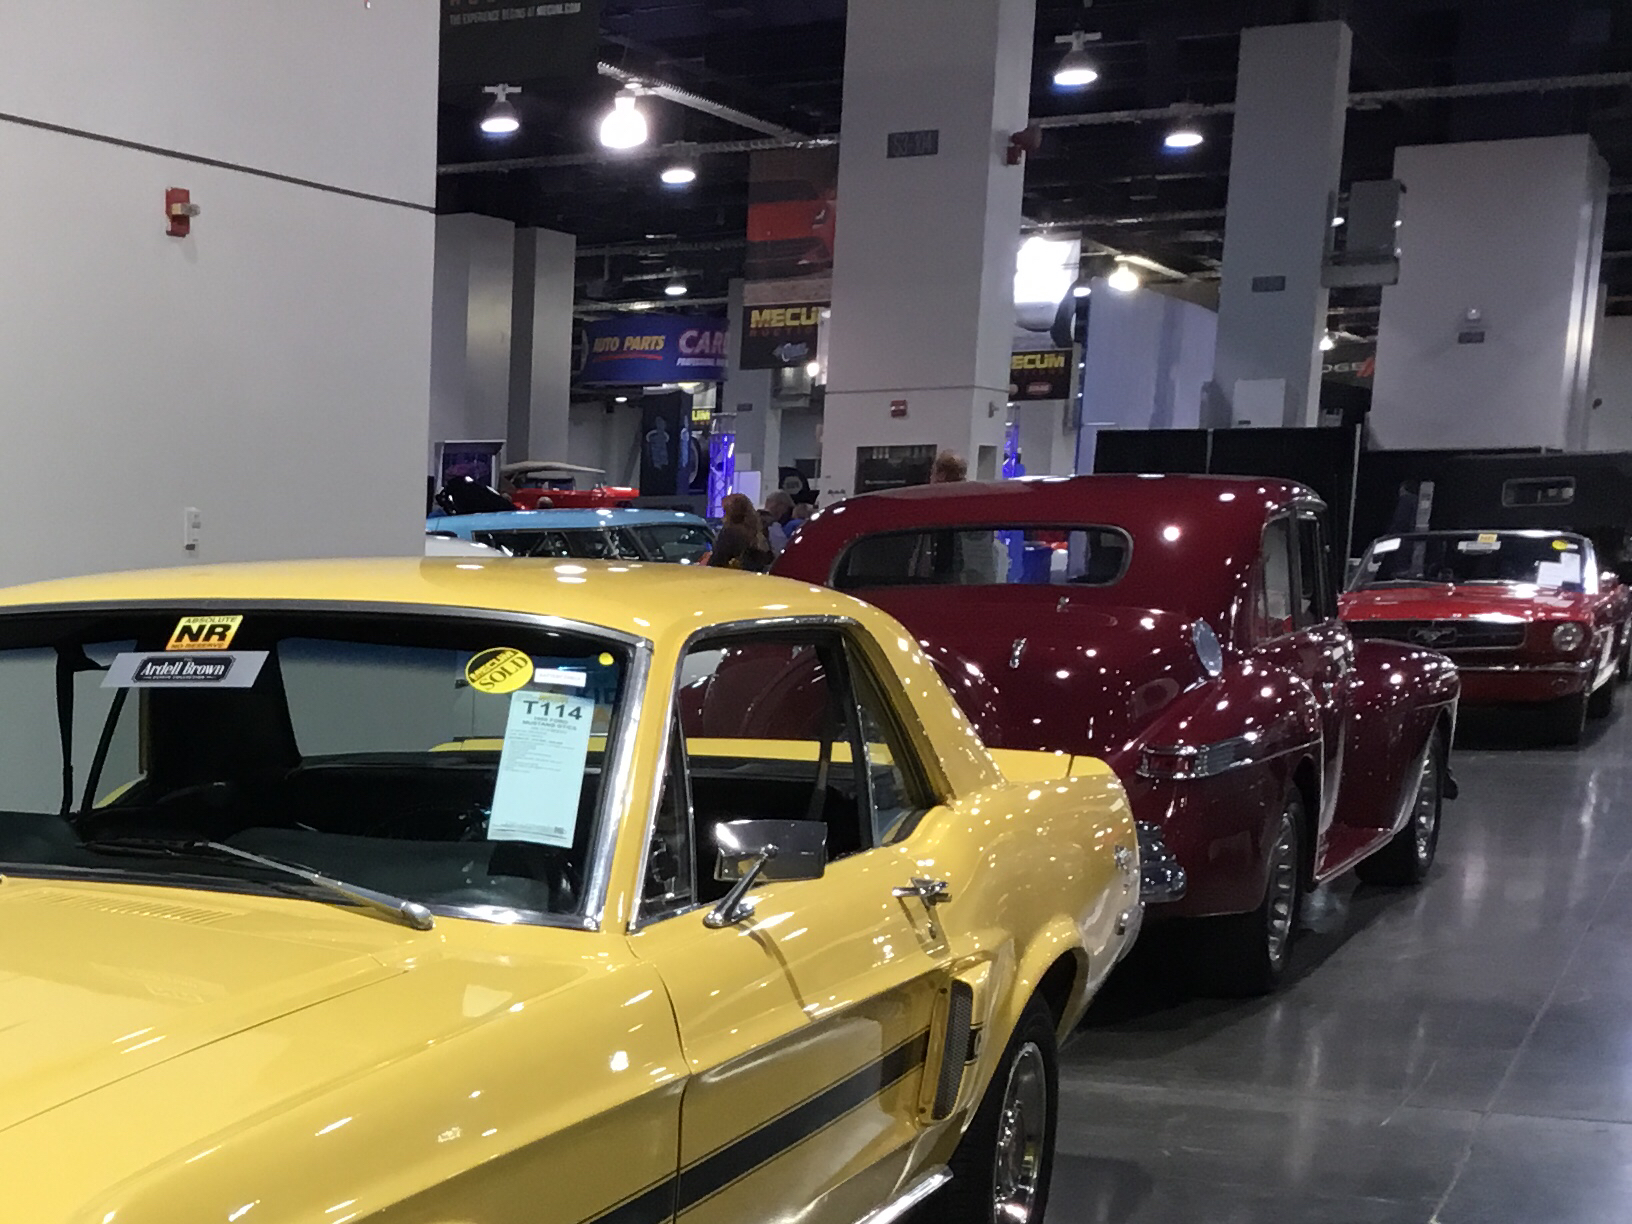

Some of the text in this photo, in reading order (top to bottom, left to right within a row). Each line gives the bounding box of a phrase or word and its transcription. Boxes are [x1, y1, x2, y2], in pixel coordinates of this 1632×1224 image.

[536, 2, 581, 16] MECUM.COM
[750, 306, 819, 328] MECU
[623, 335, 666, 351] PARTS
[1010, 353, 1065, 369] ECUM
[184, 616, 237, 624] ABSOLUTE
[174, 624, 231, 643] NR
[140, 661, 225, 676] Ardell Brown
[479, 655, 529, 690] SOLD
[523, 700, 582, 721] T114
